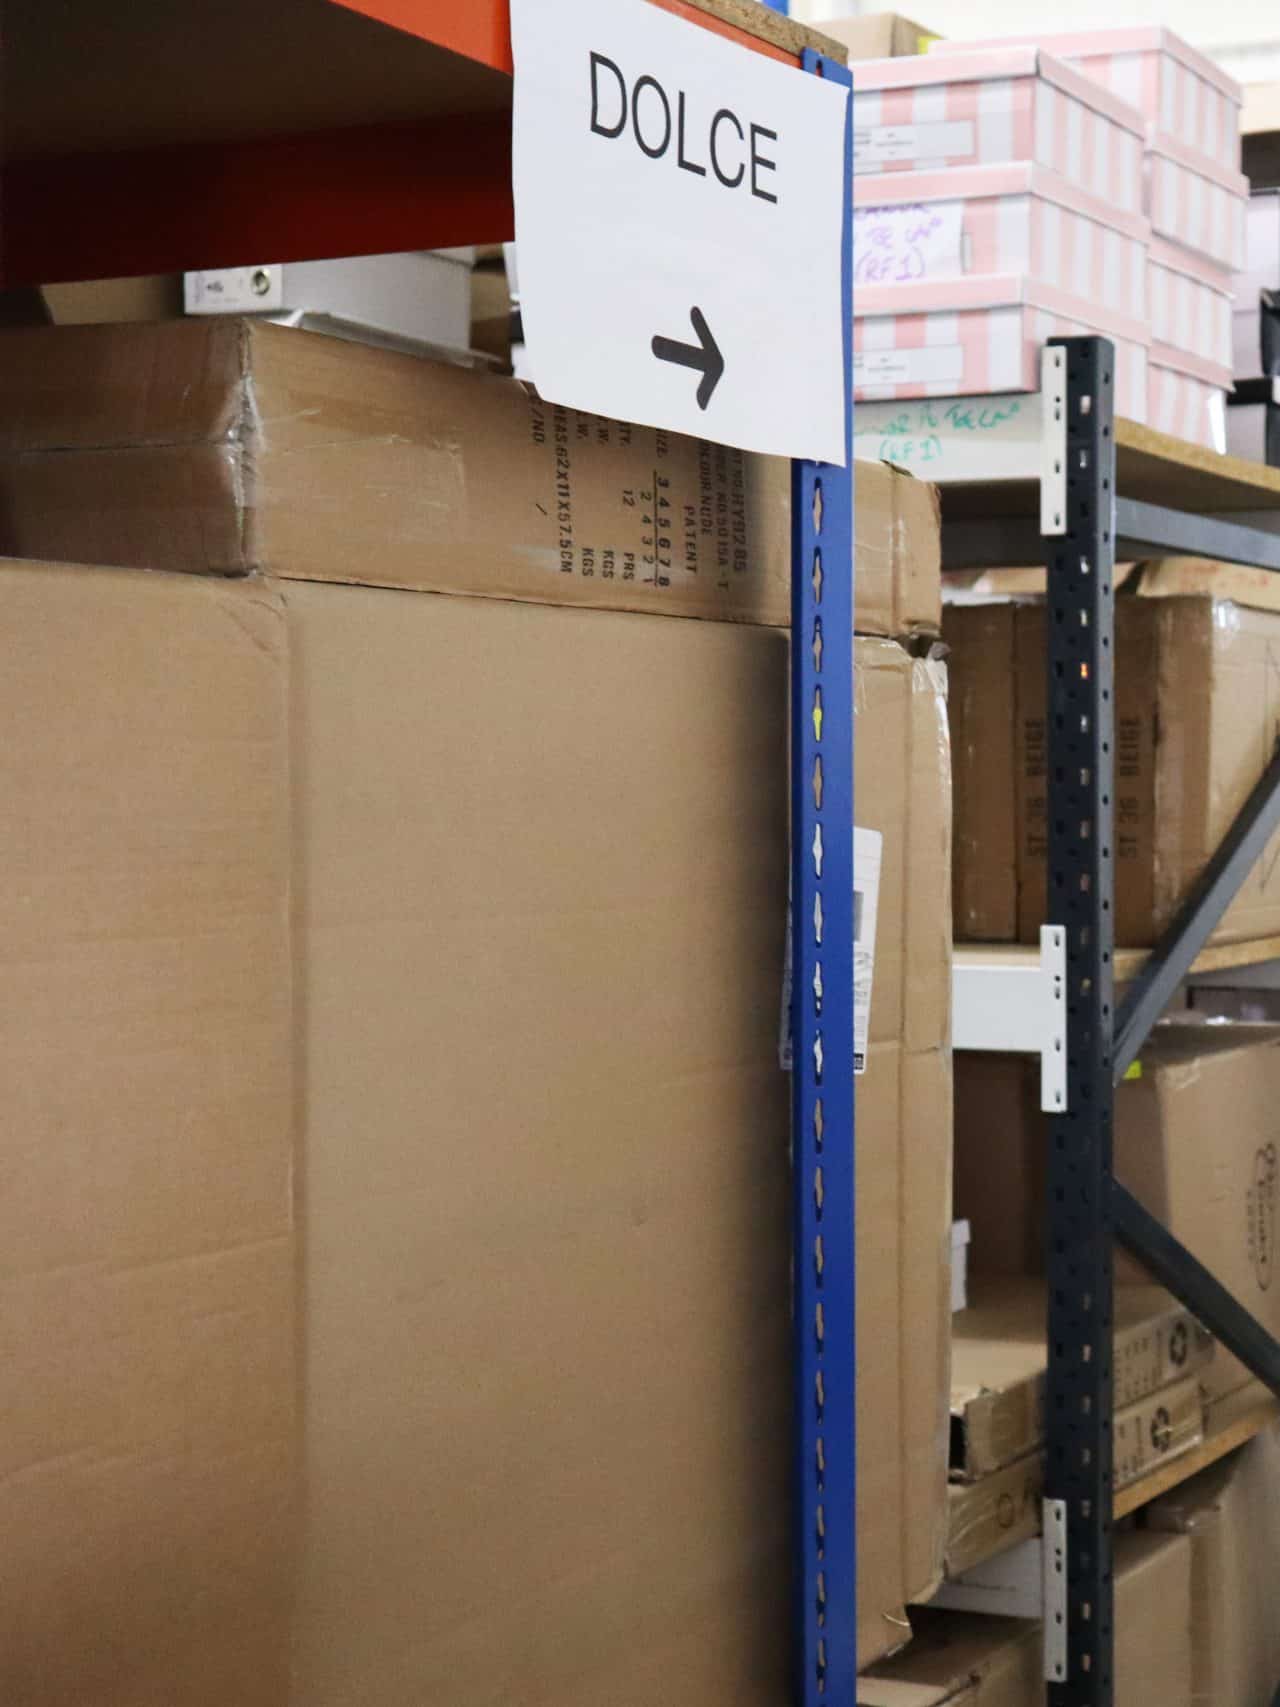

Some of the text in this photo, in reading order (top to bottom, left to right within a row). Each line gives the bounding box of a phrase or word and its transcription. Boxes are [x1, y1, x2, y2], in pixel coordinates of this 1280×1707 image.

[589, 50, 778, 204] DOLCE
[657, 476, 670, 489] 3
[622, 489, 635, 508] 12
[641, 491, 652, 502] 2
[658, 496, 671, 508] 4
[642, 515, 653, 525] 4
[658, 517, 671, 529] 5
[642, 536, 653, 546] 3
[658, 537, 671, 550] 6
[684, 505, 698, 574] PATENT
[582, 547, 594, 577] KGS
[602, 550, 614, 579] KGS
[623, 552, 635, 582] PRS
[658, 558, 671, 569] 7
[658, 576, 671, 587] 8
